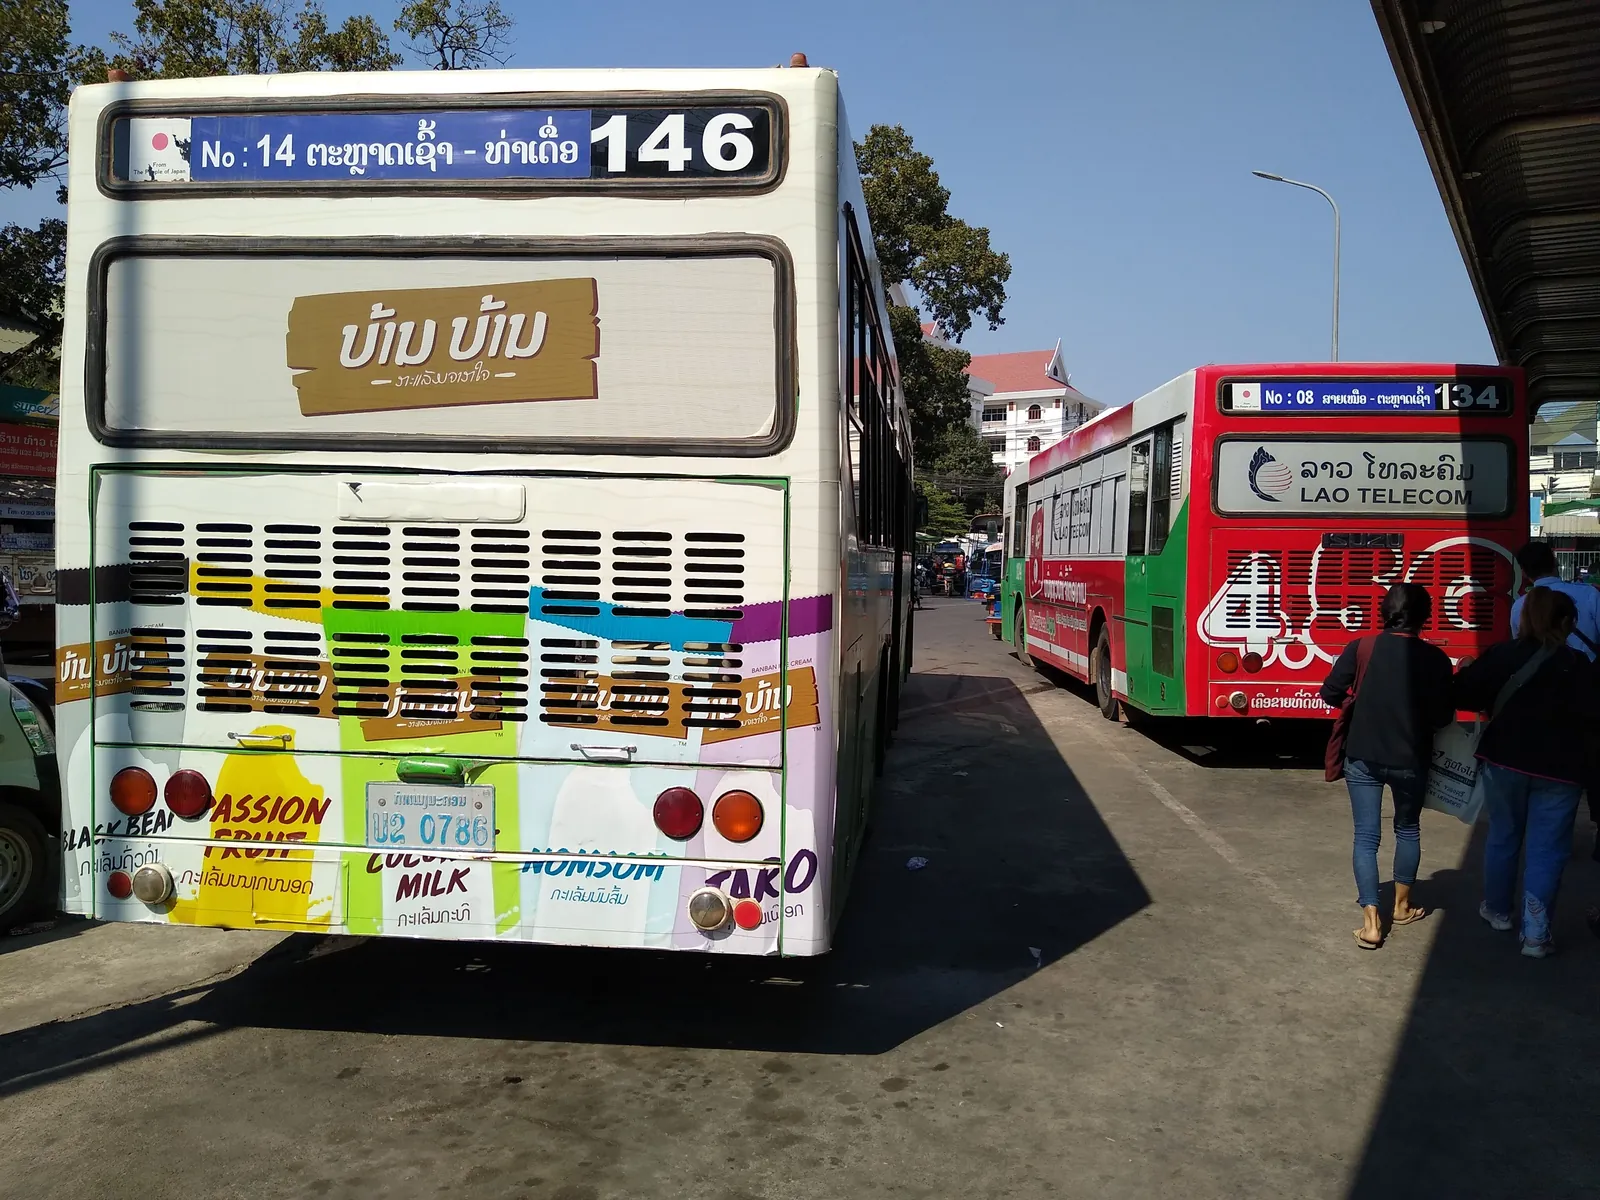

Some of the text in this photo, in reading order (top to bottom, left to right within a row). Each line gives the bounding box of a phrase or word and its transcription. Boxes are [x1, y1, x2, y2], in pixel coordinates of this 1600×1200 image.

[202, 141, 235, 168] No
[256, 133, 296, 168] 14
[590, 112, 754, 173] 146
[1265, 390, 1283, 405] No
[1296, 389, 1315, 405] 08
[1434, 384, 1500, 409] 134
[1301, 459, 1353, 480] ລາວ
[1301, 487, 1473, 506] LAO TELECOM
[751, 664, 778, 674] BANBAN
[790, 657, 813, 667] CREAM
[204, 828, 308, 861] FRUIT
[420, 812, 488, 847] 0786
[521, 847, 669, 883] NOMSOM
[395, 867, 471, 903] MILK
